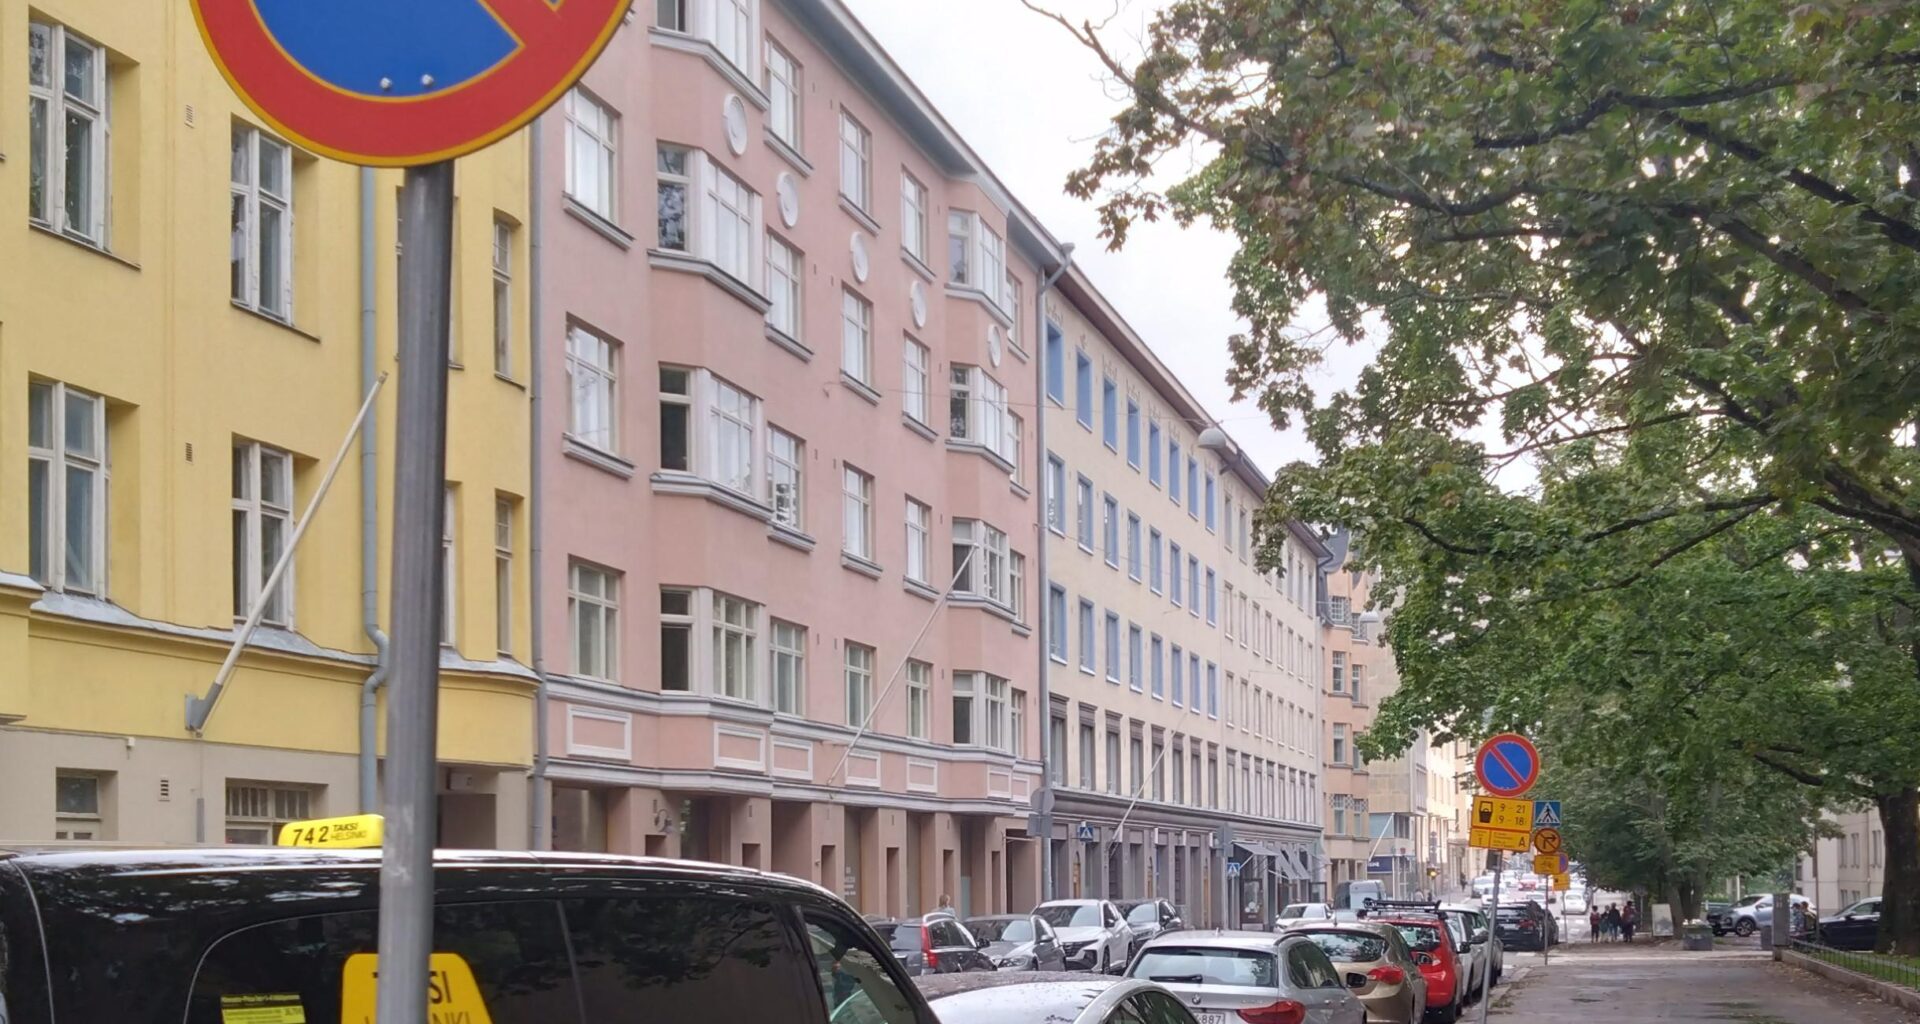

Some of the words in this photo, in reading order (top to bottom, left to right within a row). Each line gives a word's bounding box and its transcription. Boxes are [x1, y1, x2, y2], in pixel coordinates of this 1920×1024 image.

[1516, 805, 1525, 814] 21
[333, 823, 358, 831] TAKSI
[293, 825, 329, 846] 742
[331, 831, 366, 840] HELSINKI
[1518, 836, 1526, 847] A
